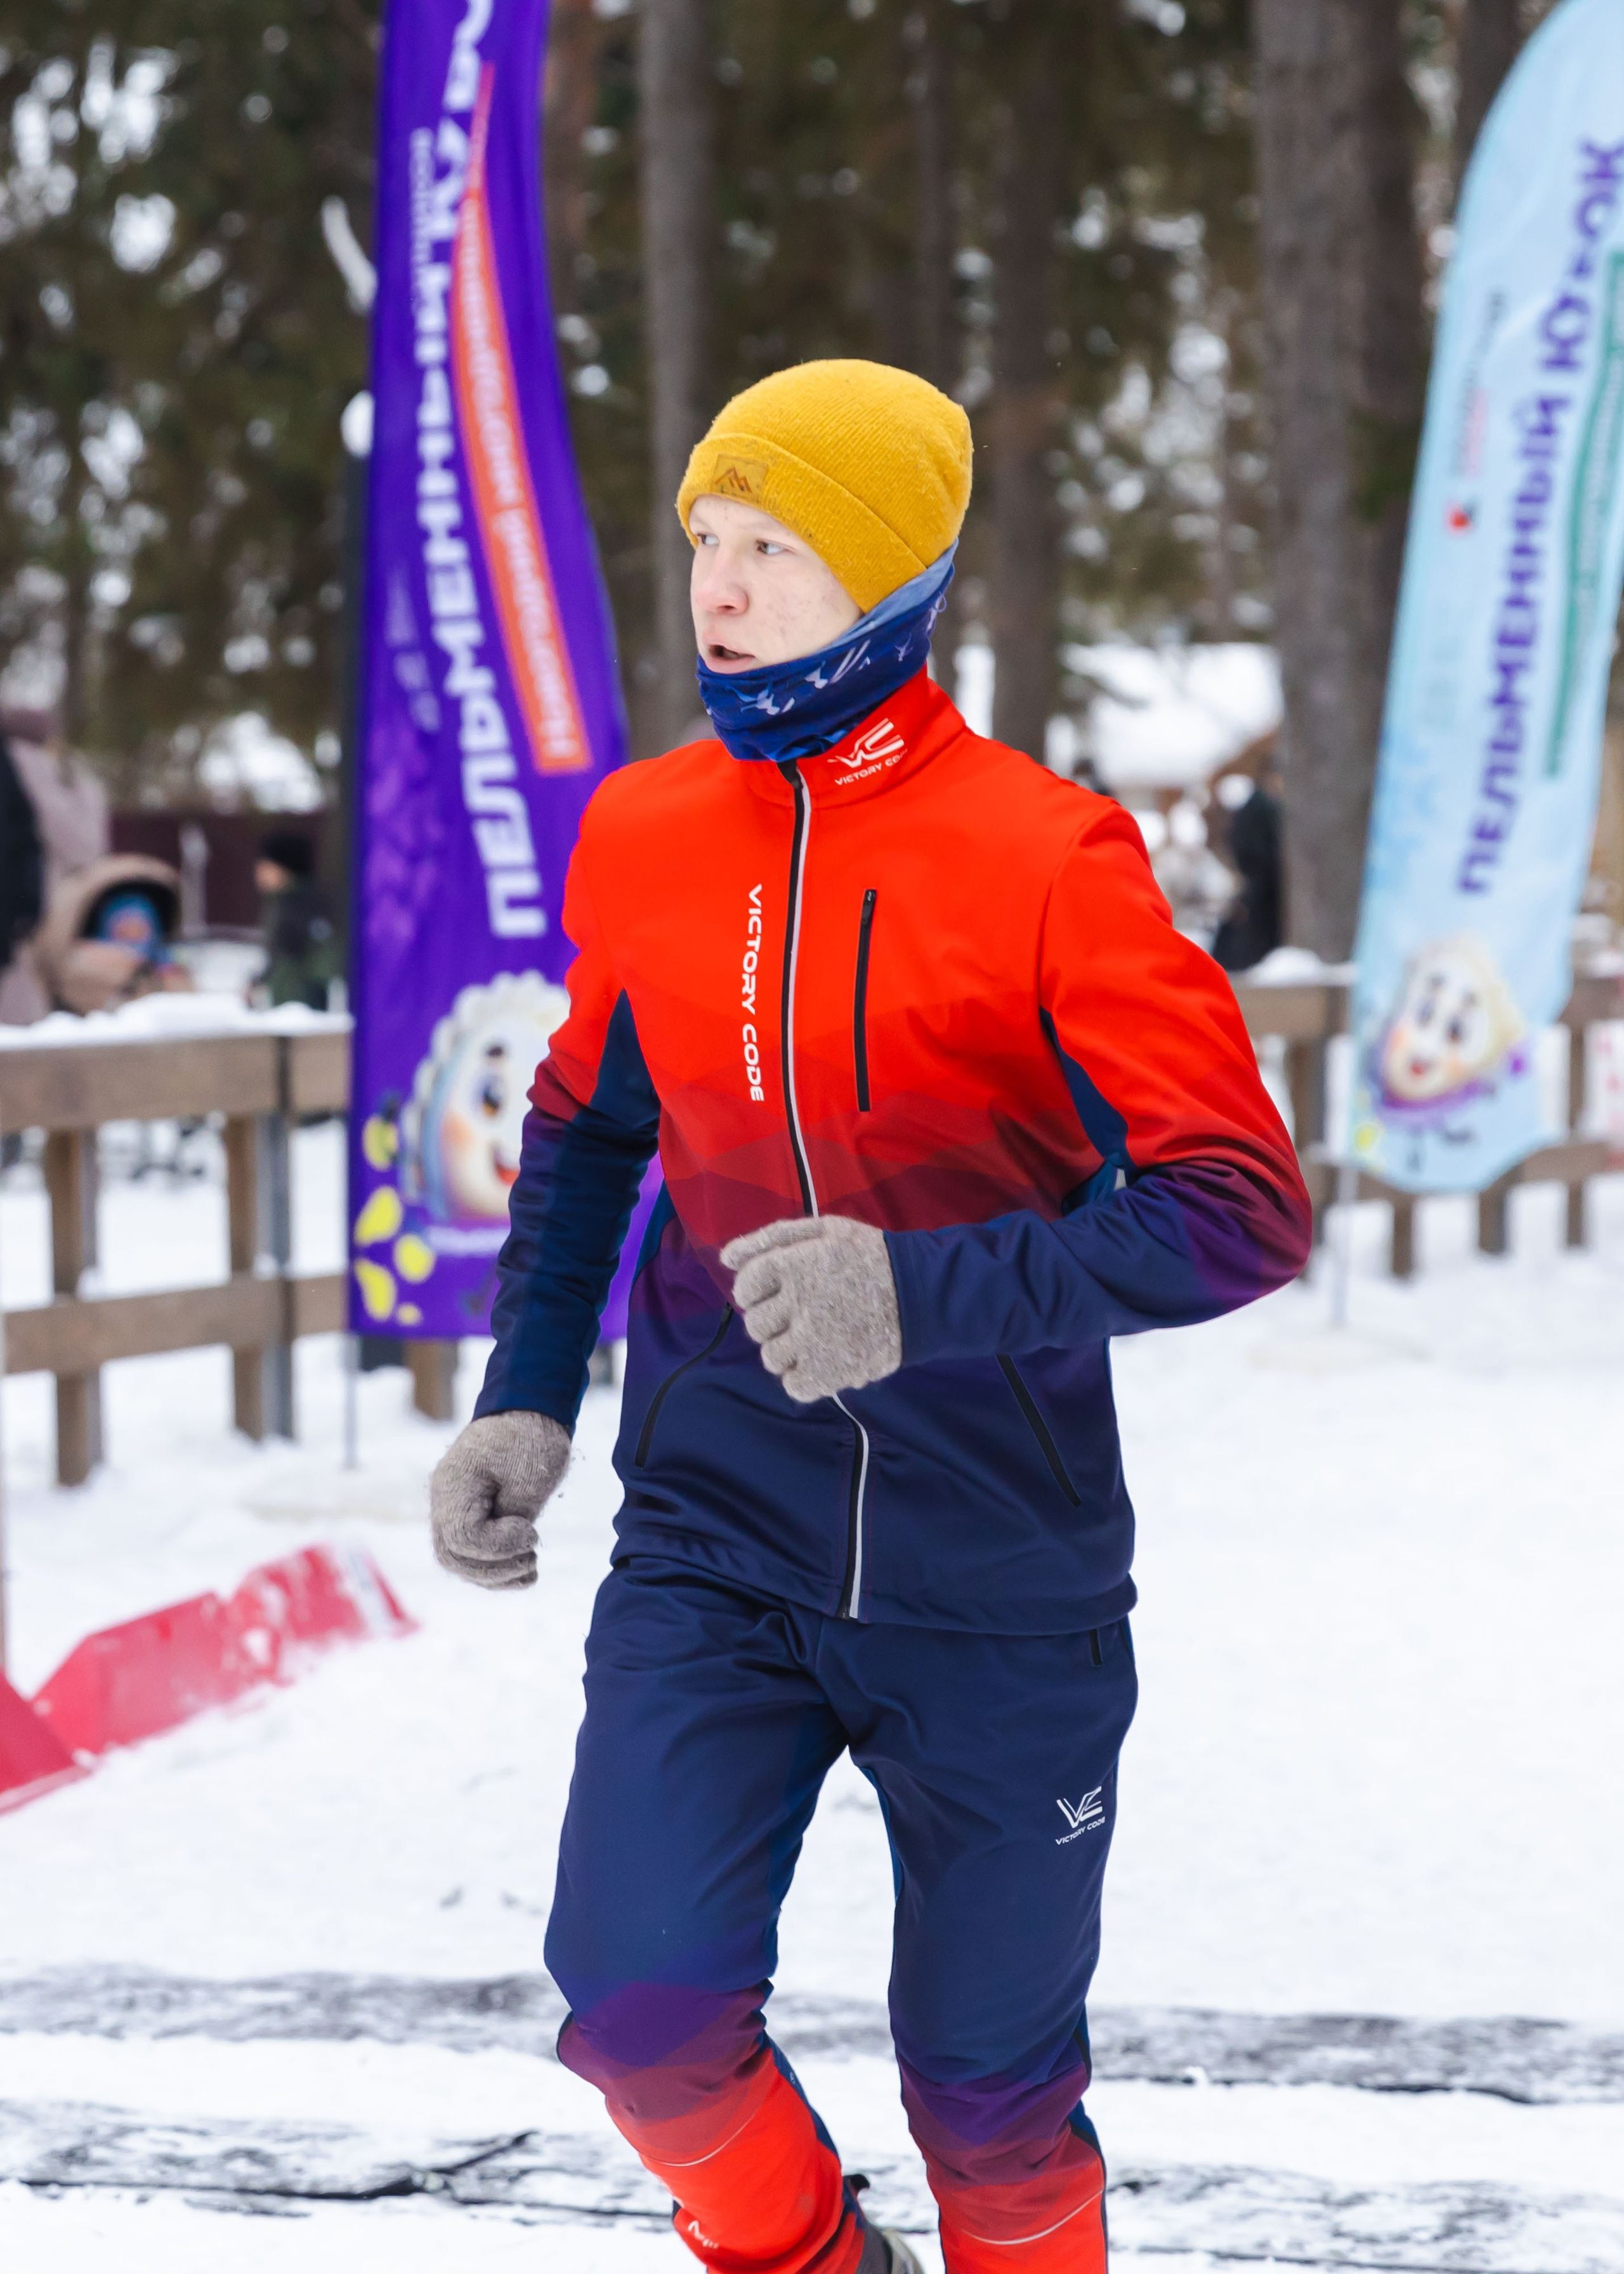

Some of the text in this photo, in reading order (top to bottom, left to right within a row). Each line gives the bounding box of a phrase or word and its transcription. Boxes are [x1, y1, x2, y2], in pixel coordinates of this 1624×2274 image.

[1458, 395, 1571, 895] ПЕЛЬМЕННЫЙ
[834, 762, 882, 785] VICTORY
[741, 883, 764, 1102] VICTORY CODE
[1055, 1816, 1106, 1845] VICTORY CODE
